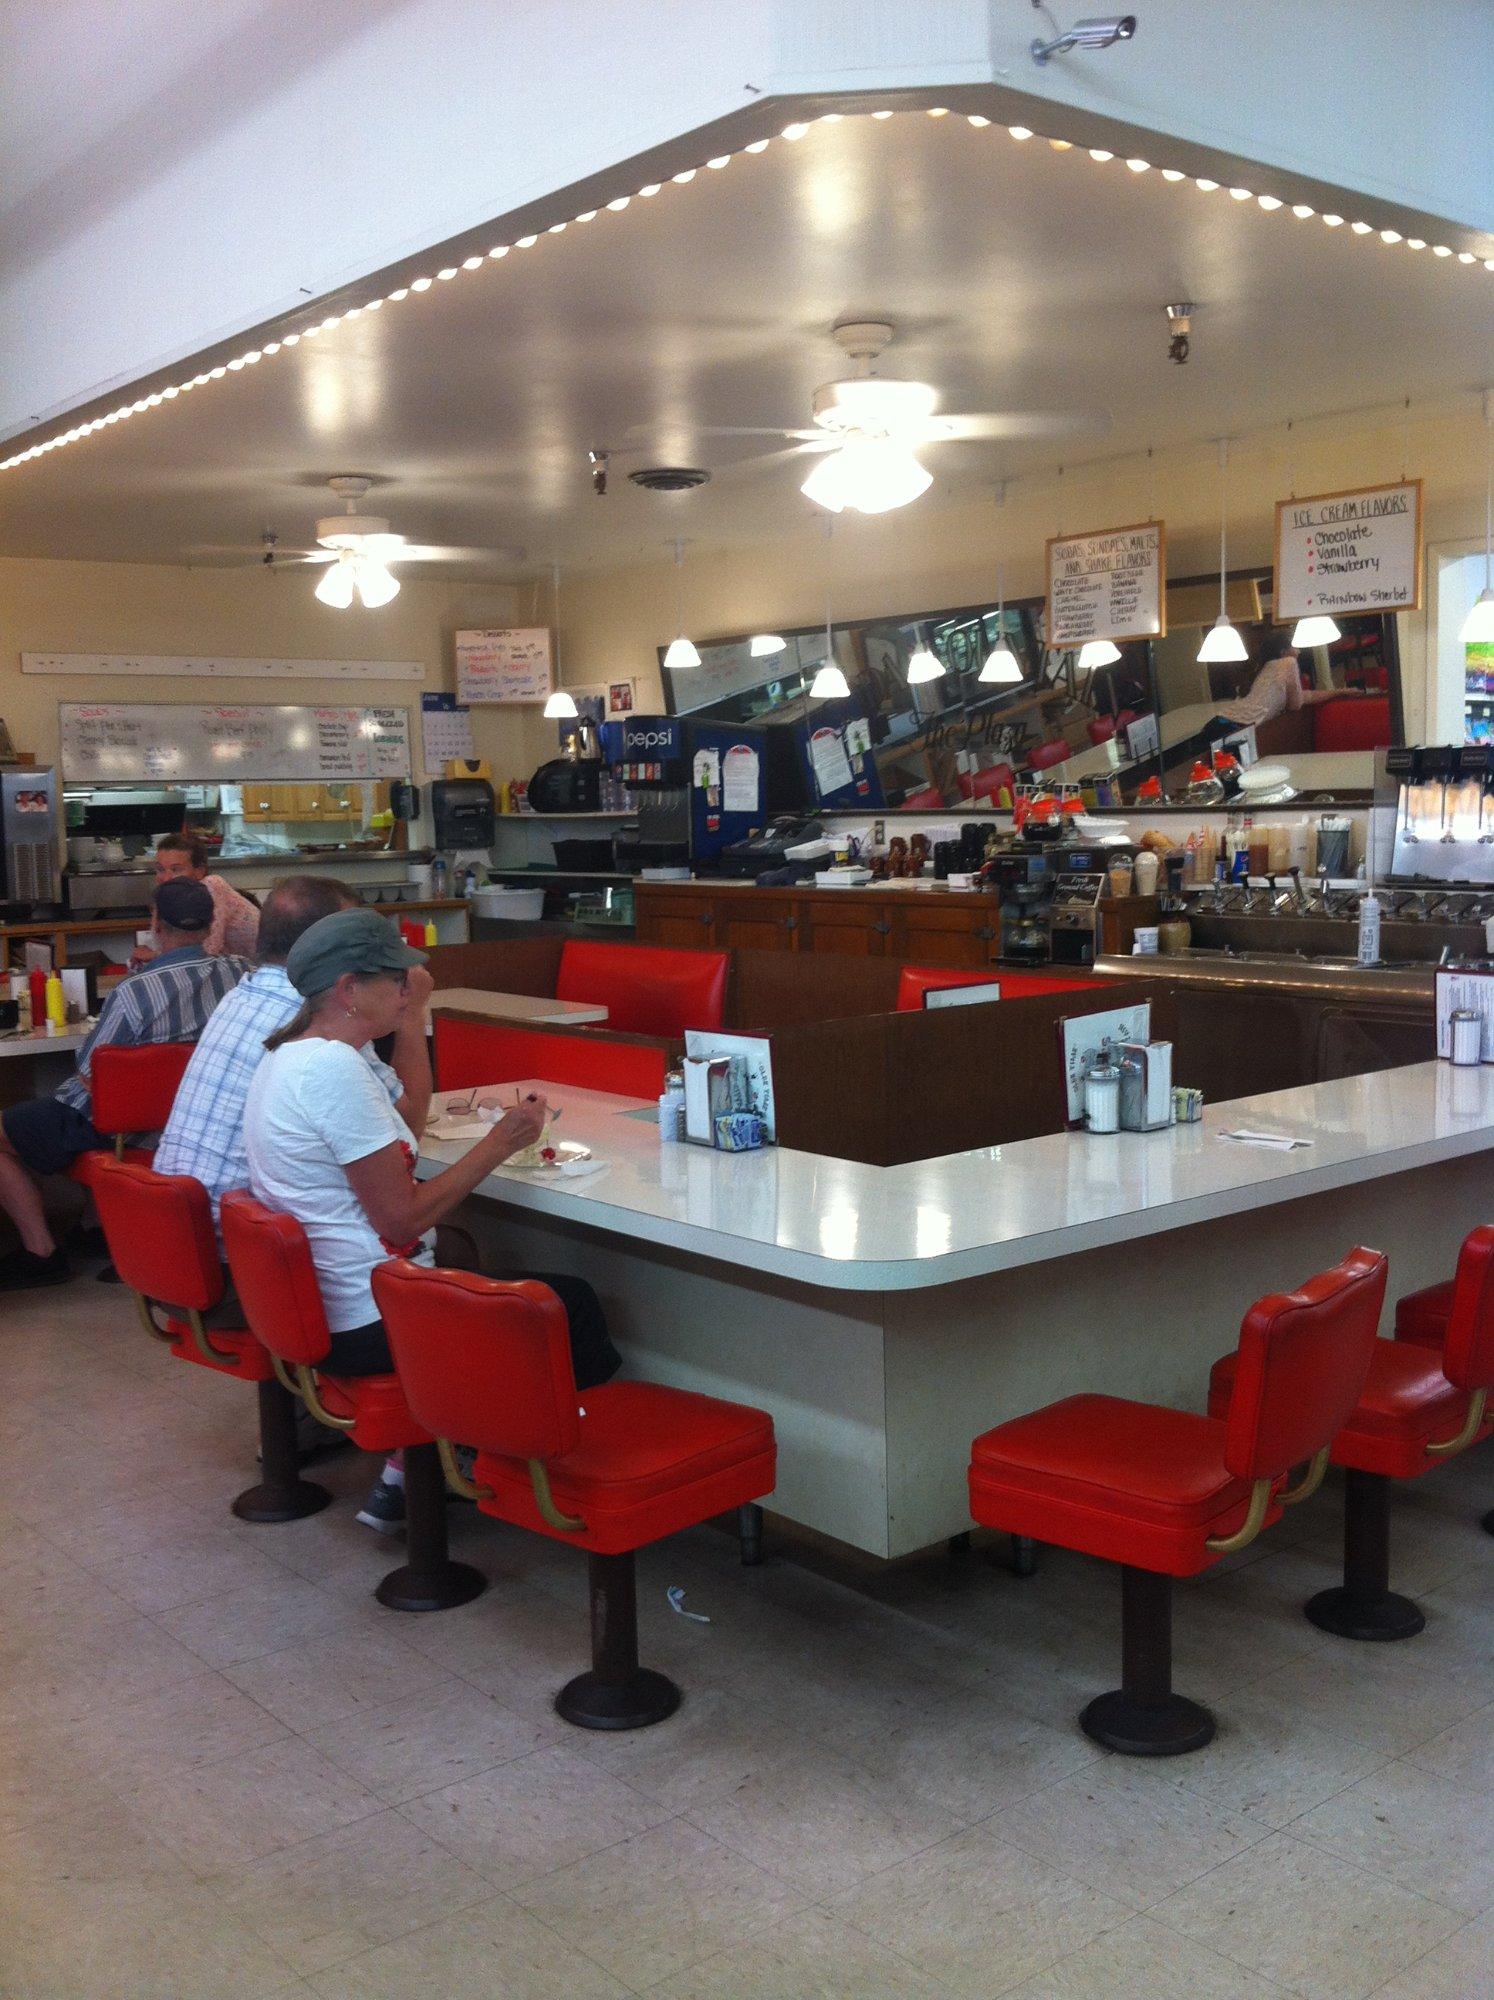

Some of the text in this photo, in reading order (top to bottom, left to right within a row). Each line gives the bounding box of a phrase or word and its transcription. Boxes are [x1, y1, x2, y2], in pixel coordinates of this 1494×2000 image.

[1294, 495, 1407, 526] ICE CREAM FLAVORS
[1315, 524, 1373, 546] Chocolate
[1317, 544, 1357, 559] Vanilla
[1085, 557, 1112, 571] SHAKE
[1116, 551, 1152, 569] FLAVORS
[1317, 558, 1379, 575] Strawberry
[1053, 577, 1088, 588] CHOCOLATE
[1370, 586, 1408, 601] Sherbet
[626, 728, 673, 750] pepsi
